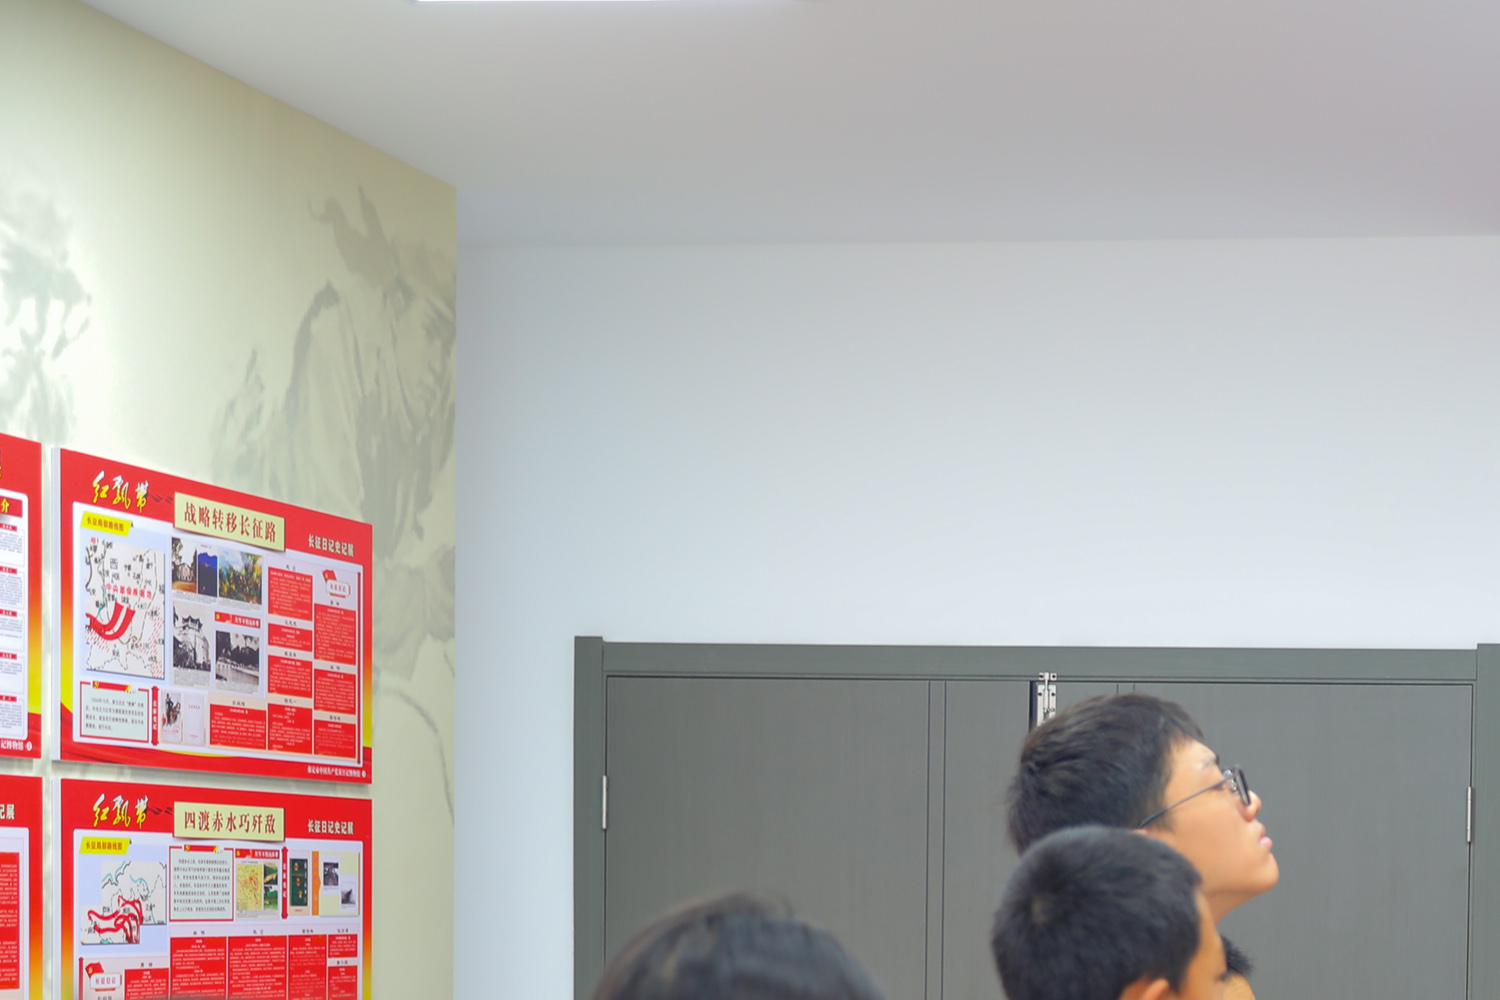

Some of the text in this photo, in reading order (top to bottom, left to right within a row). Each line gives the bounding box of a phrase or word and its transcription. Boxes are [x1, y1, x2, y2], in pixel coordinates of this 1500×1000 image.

[184, 502, 277, 543] 战略转移长征路
[308, 534, 354, 557] 长征日记史记展
[184, 811, 276, 835] 四渡赤水巧歼敌
[307, 819, 354, 835] 长征日记史记展
